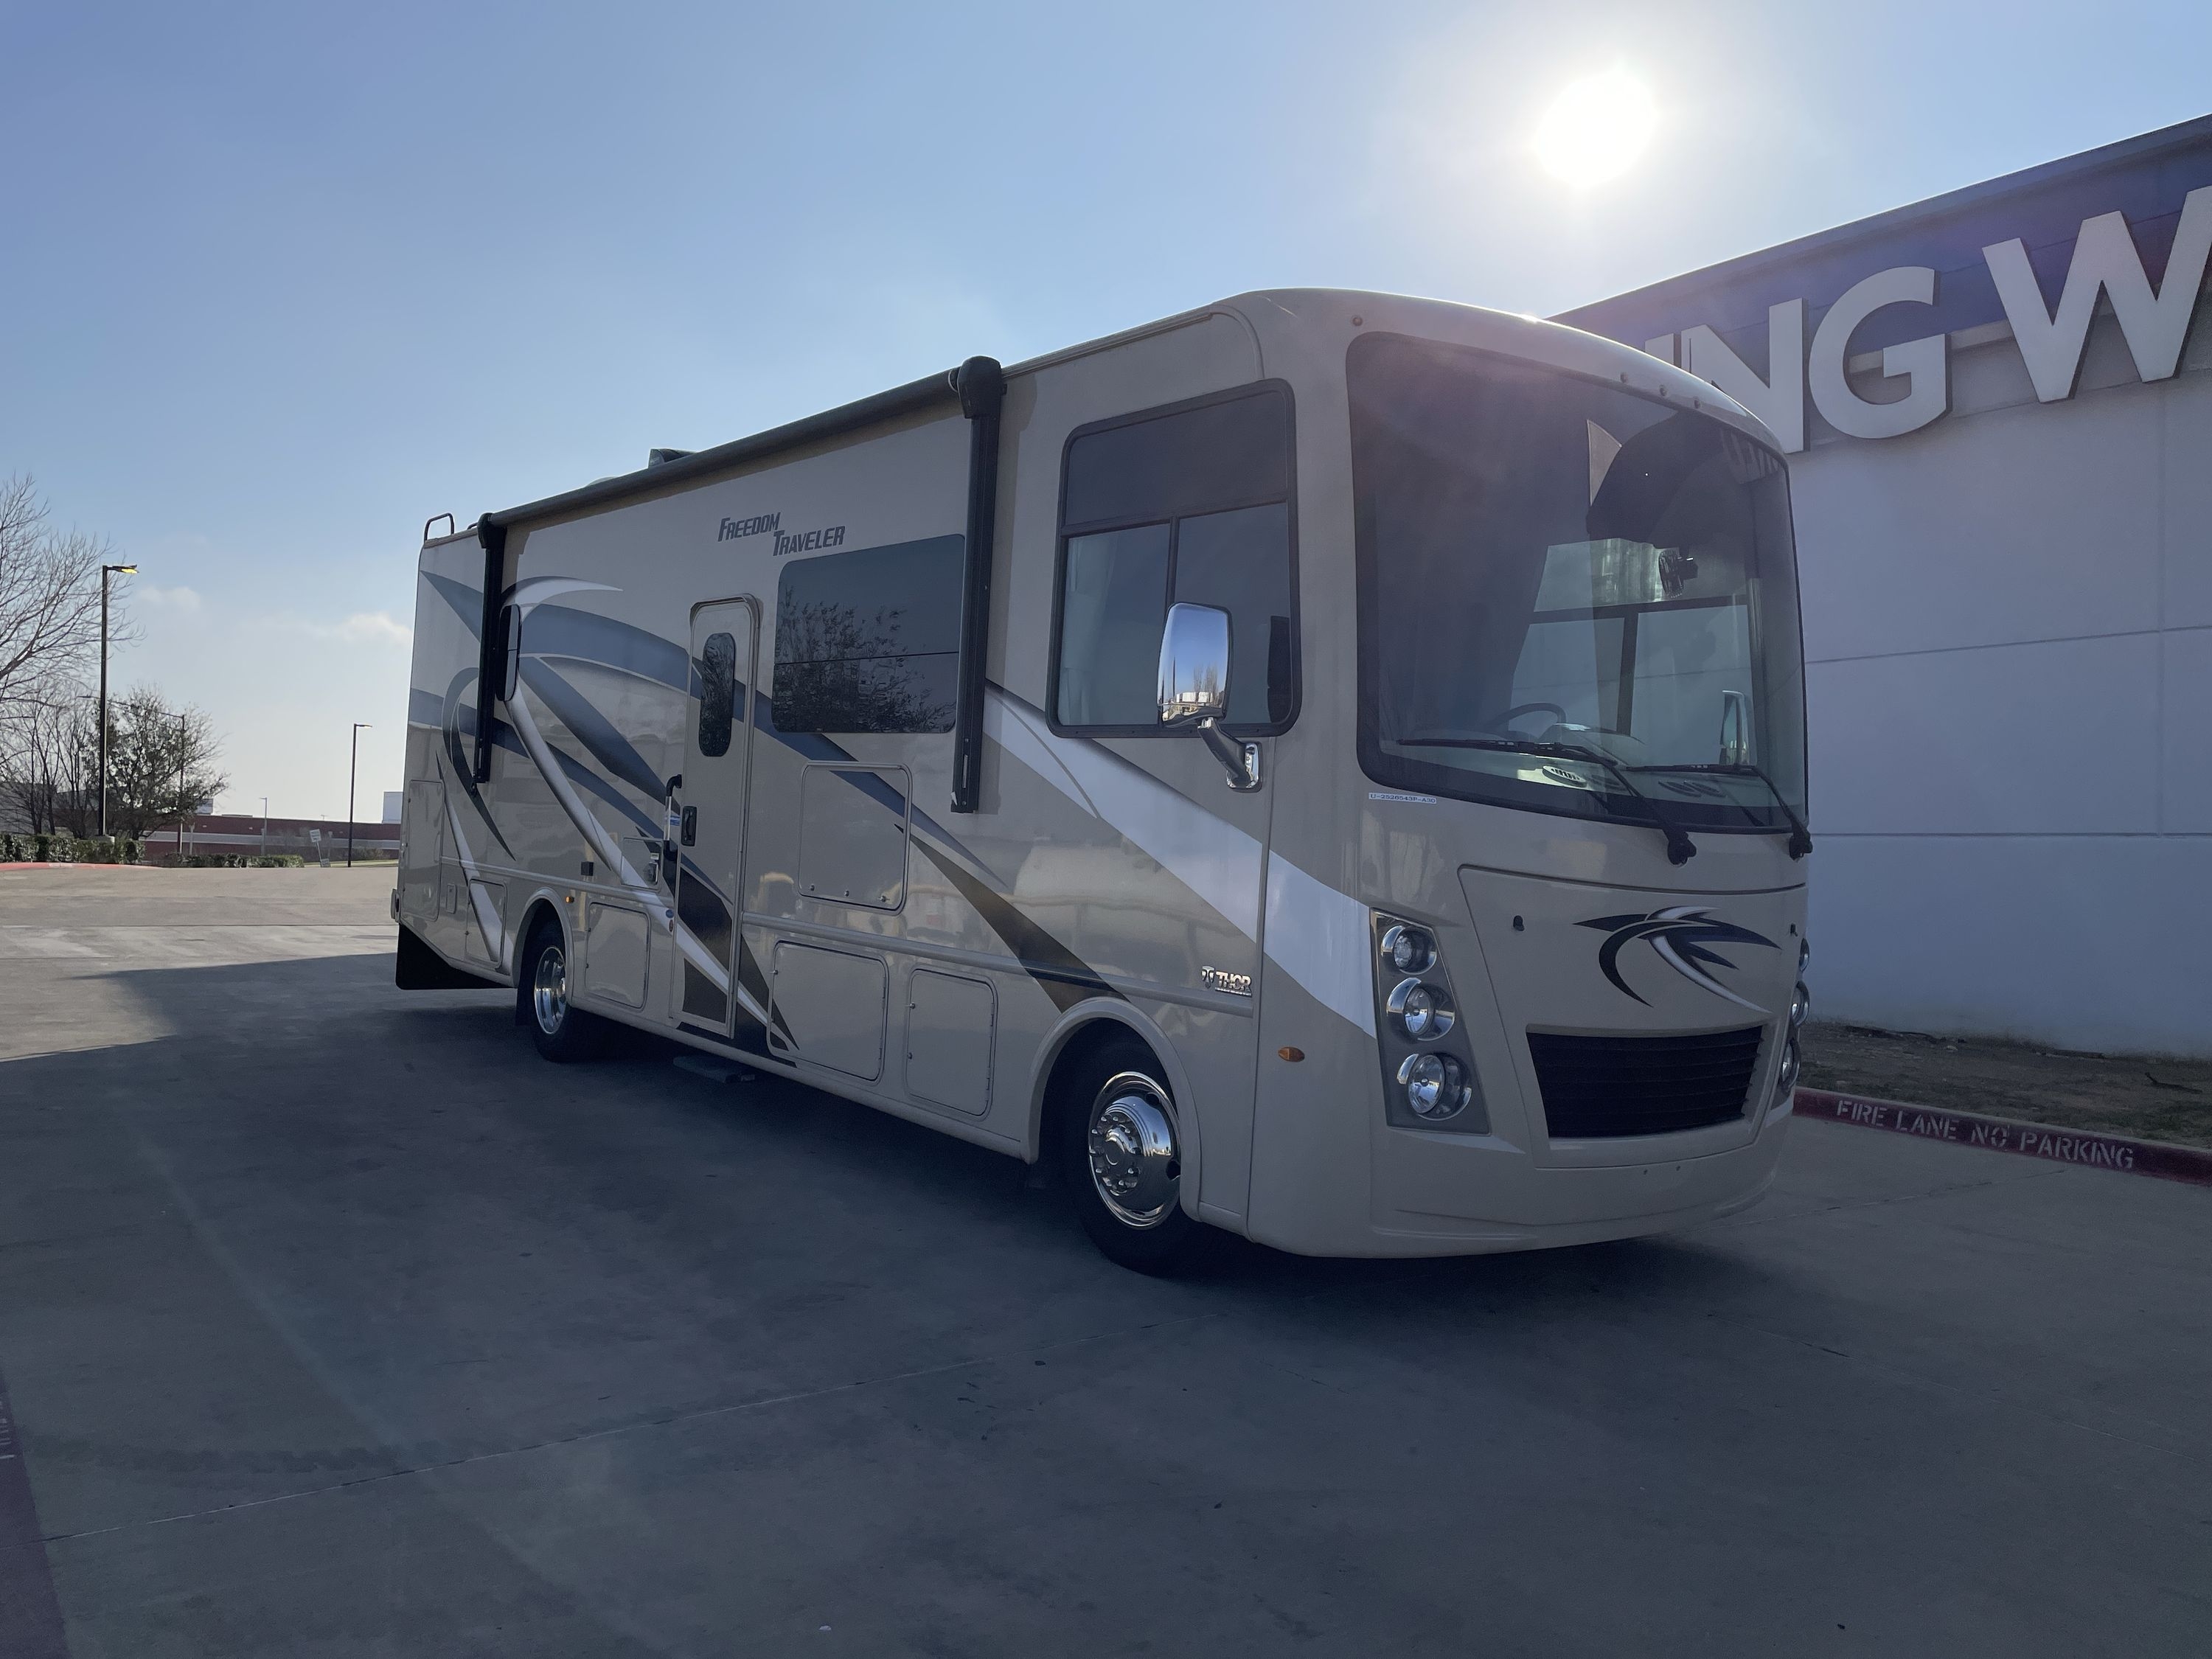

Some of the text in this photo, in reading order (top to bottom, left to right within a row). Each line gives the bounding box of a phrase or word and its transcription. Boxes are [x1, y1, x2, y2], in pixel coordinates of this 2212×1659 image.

[1645, 185, 2212, 454] NG W
[773, 526, 846, 556] TRAVELER
[1216, 971, 1252, 992] THOR
[1837, 1099, 2134, 1169] FIRE LANE NO PARKING
